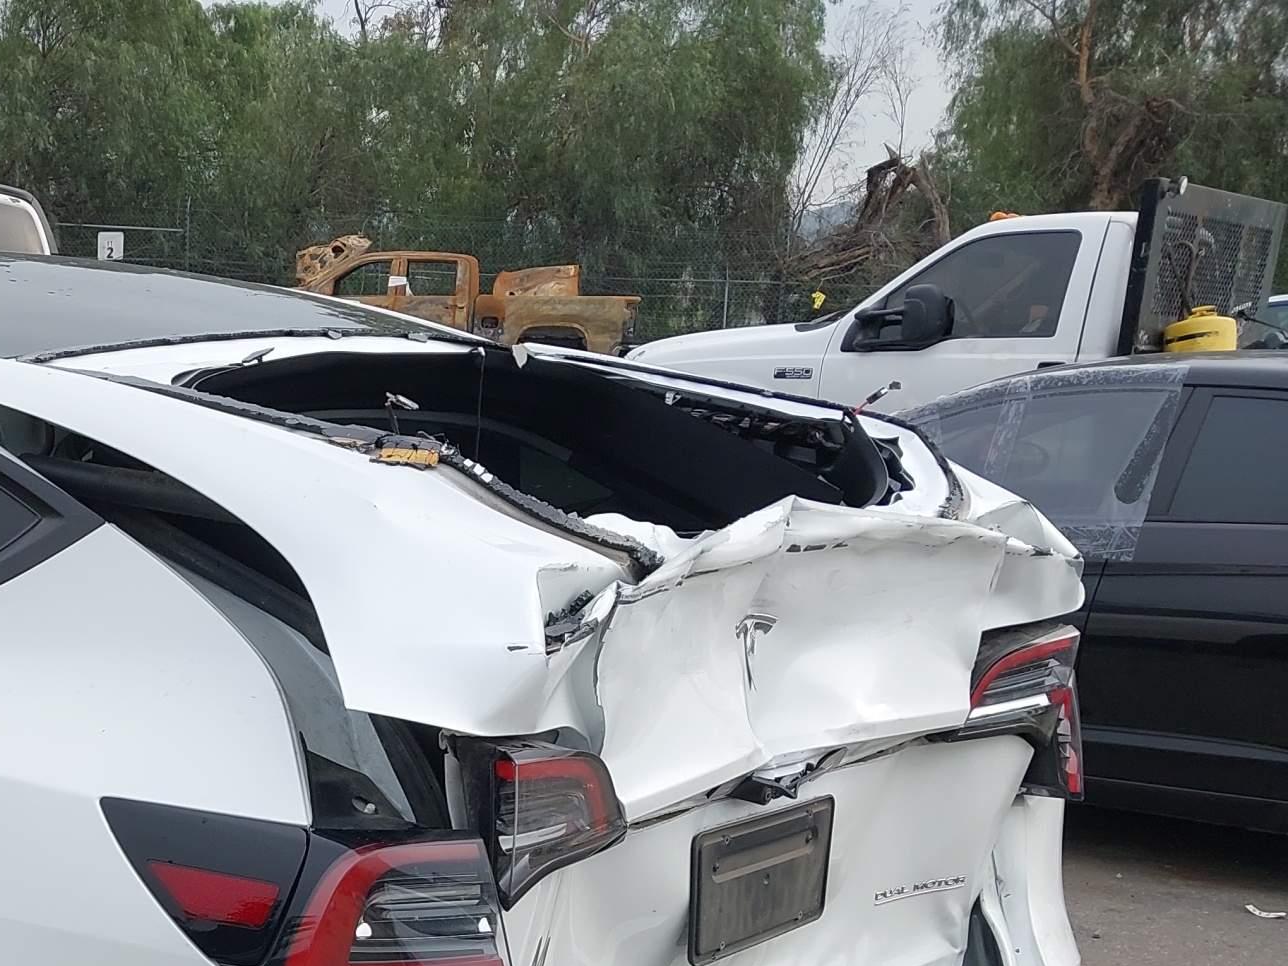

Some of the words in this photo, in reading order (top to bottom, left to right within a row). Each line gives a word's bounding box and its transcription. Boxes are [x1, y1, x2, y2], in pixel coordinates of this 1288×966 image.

[107, 247, 114, 258] 2
[874, 886, 909, 901] DUAL
[913, 875, 967, 892] MOTOR
